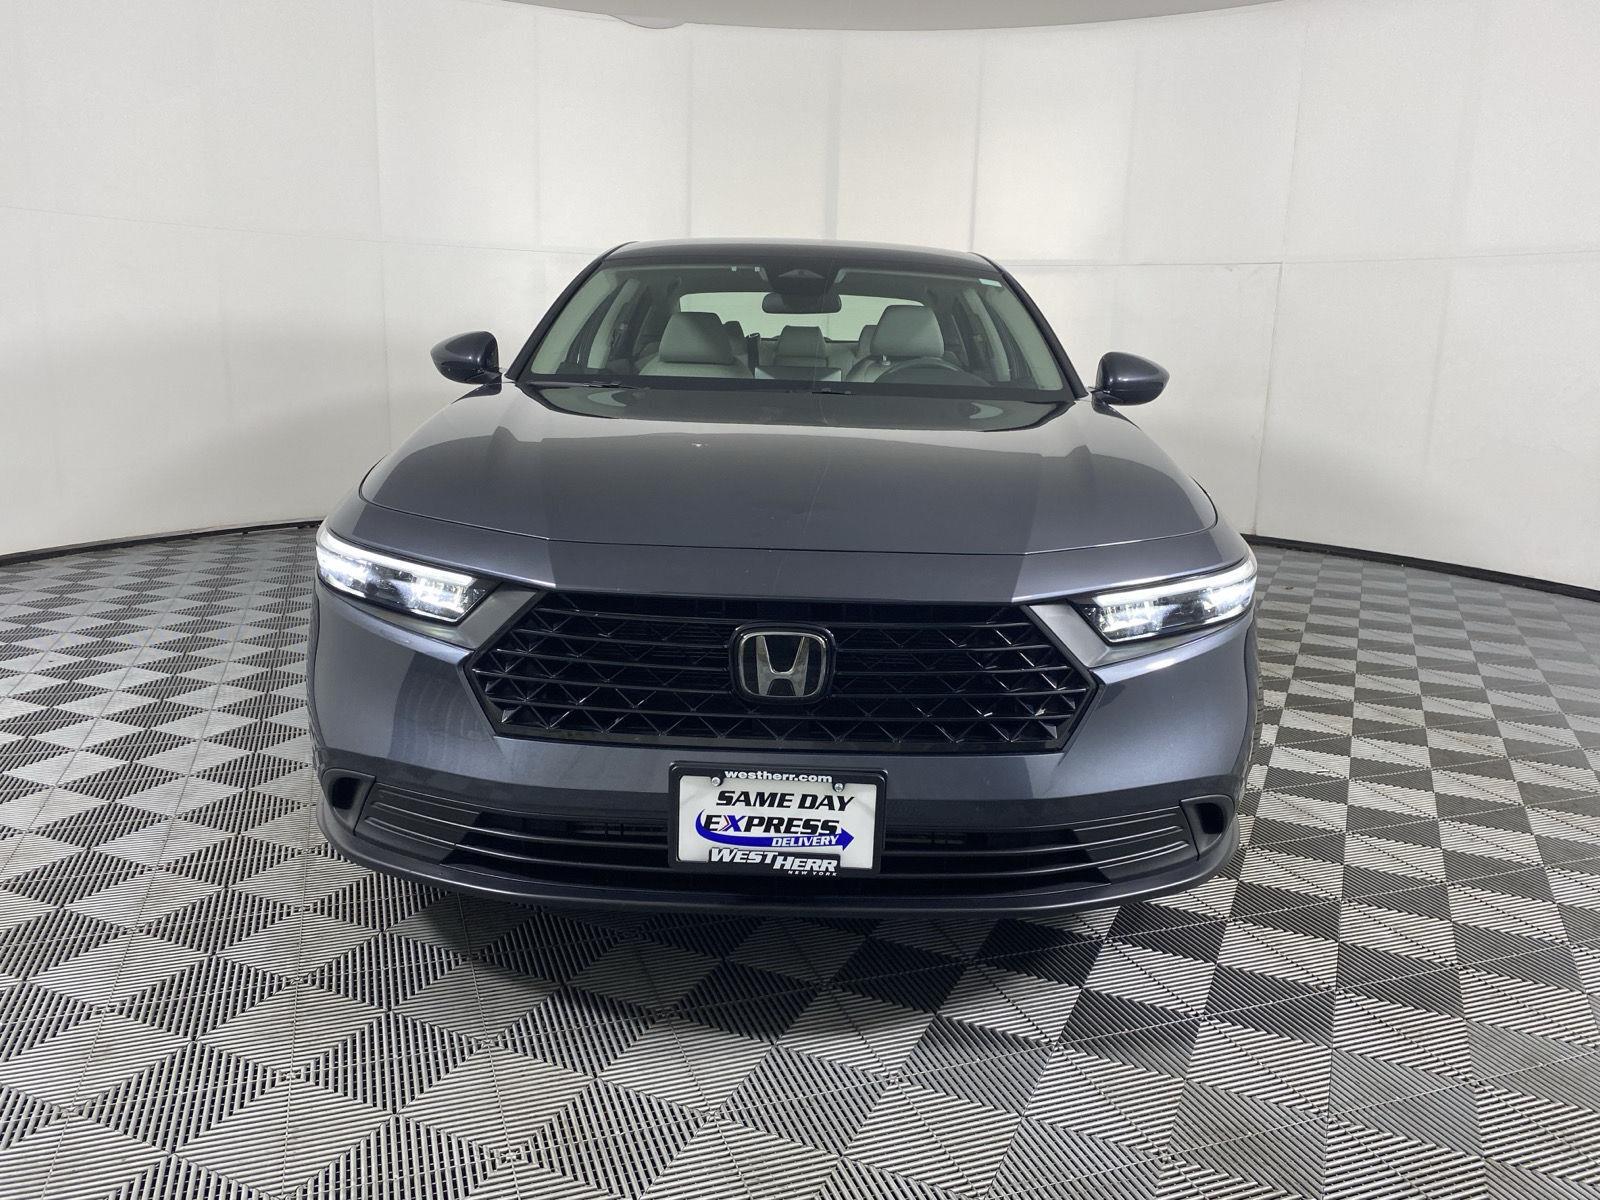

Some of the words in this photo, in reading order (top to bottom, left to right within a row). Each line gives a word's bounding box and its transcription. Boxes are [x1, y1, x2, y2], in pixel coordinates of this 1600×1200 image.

[724, 770, 832, 783] westherr.com
[716, 791, 795, 809] SAME
[798, 793, 854, 811] DAY
[703, 814, 840, 836] EXPRESS
[771, 834, 839, 847] DELIVERY
